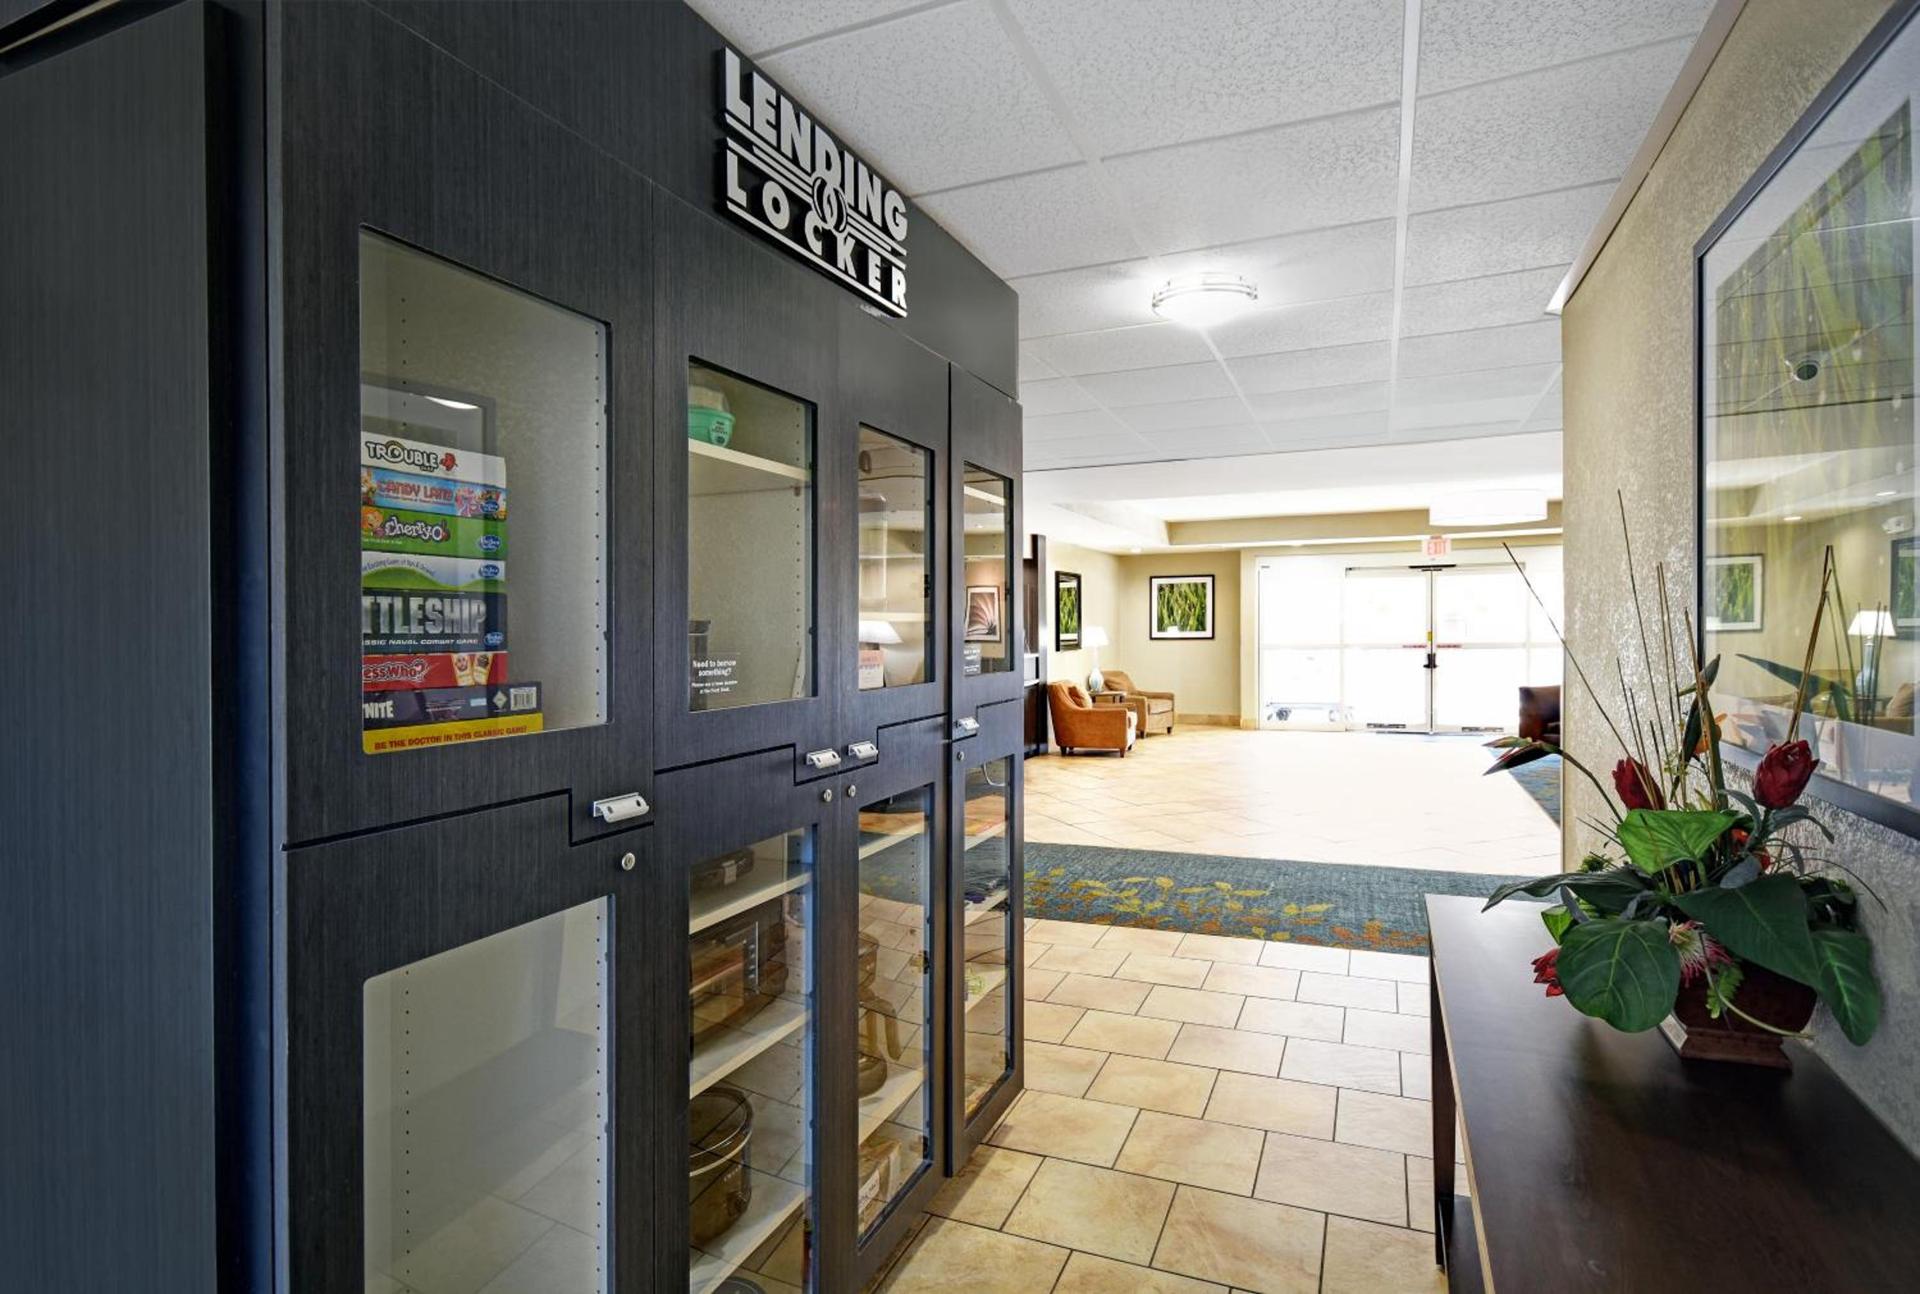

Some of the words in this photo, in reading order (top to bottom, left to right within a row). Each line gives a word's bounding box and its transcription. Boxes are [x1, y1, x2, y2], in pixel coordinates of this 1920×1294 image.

[725, 46, 907, 241] LENDING
[727, 149, 907, 309] LOCKER
[366, 440, 438, 467] TROUBLE
[376, 481, 420, 498] CANDY
[423, 485, 453, 501] LAND
[692, 660, 708, 668] Need
[698, 667, 732, 676] something?
[362, 700, 394, 718] NITE
[375, 742, 387, 751] BE
[389, 740, 406, 749] THE
[408, 736, 442, 747] DOCTOR
[444, 734, 453, 742] IN
[455, 732, 472, 741] THIS
[473, 728, 504, 738] CLASSIC
